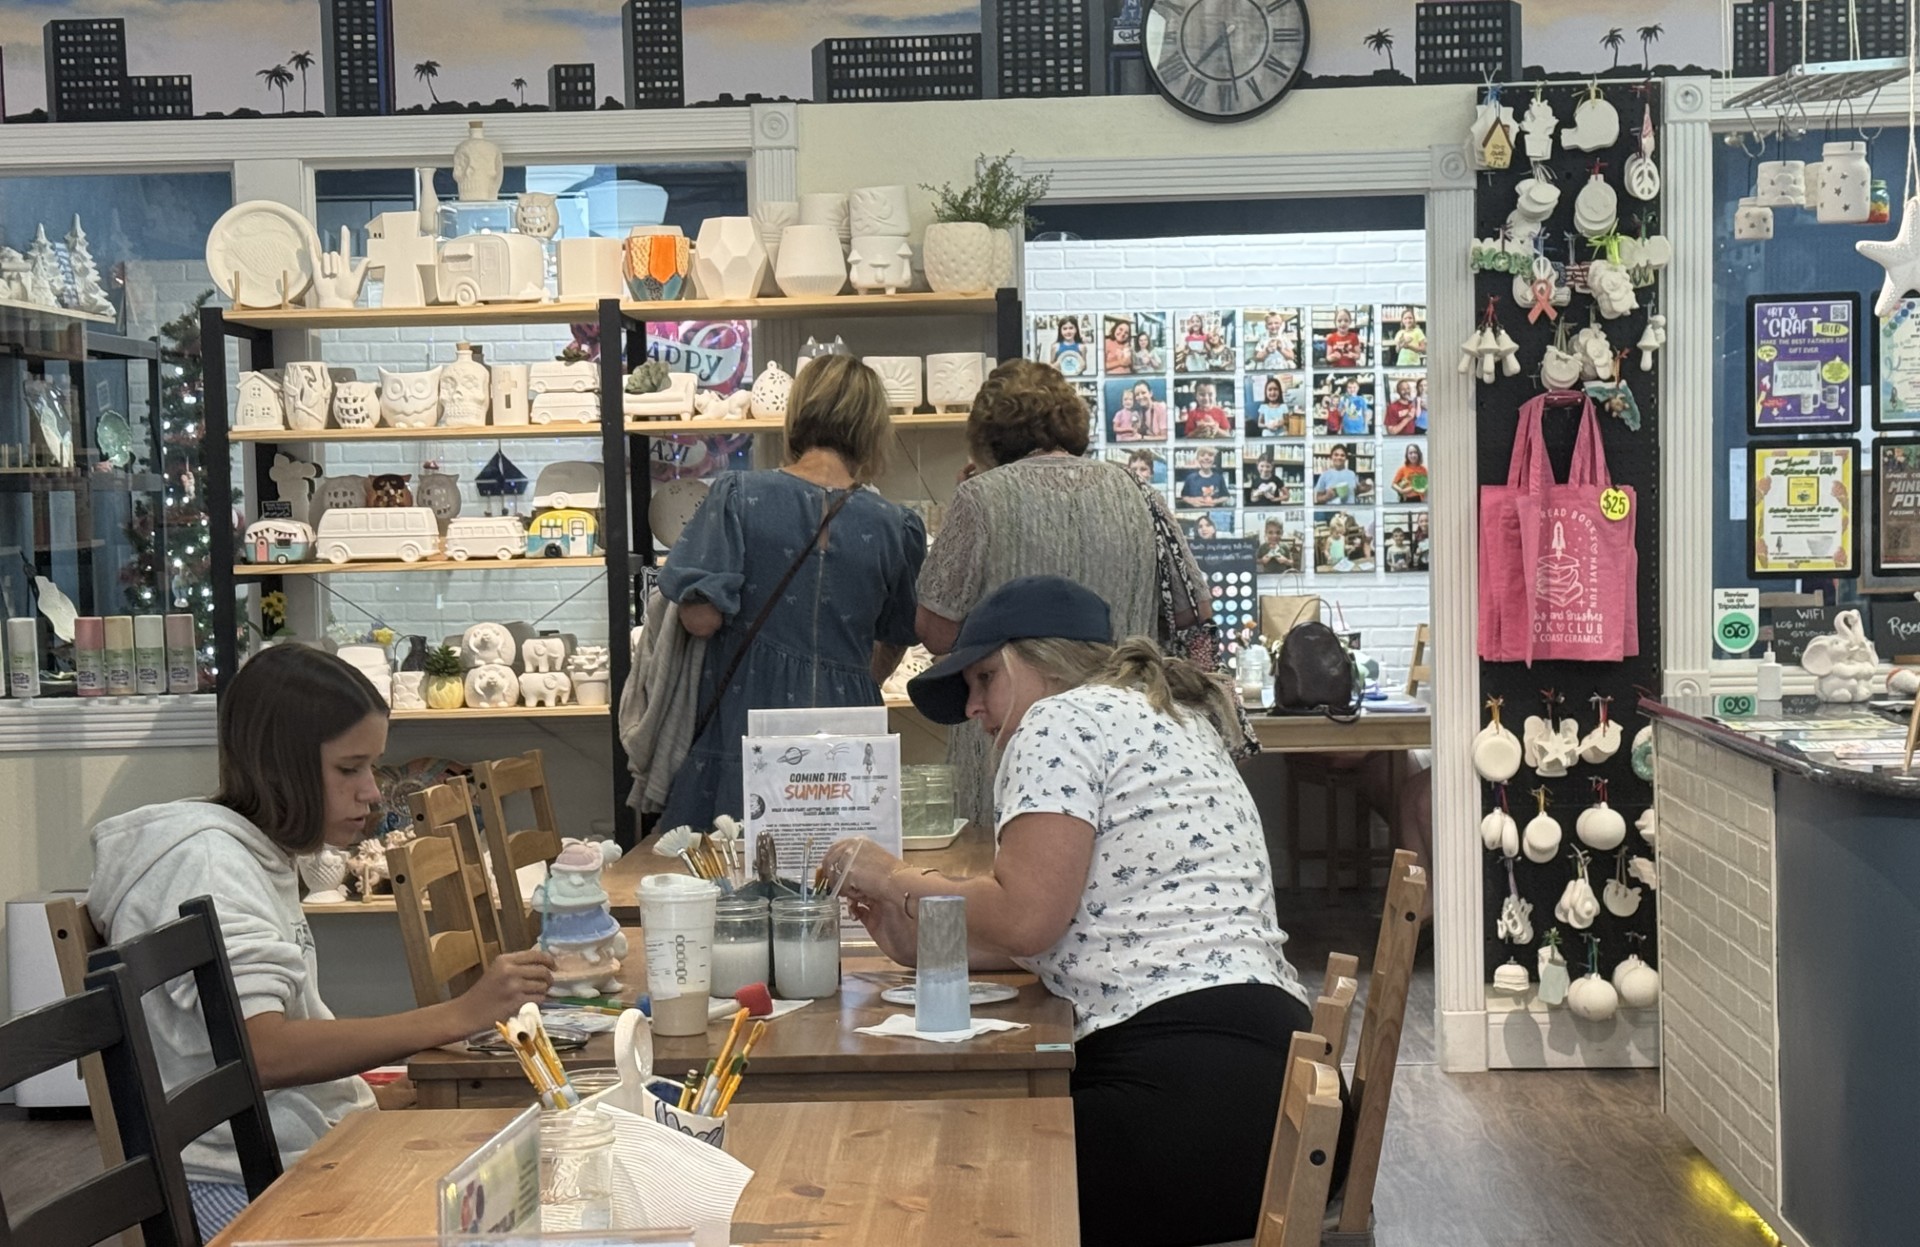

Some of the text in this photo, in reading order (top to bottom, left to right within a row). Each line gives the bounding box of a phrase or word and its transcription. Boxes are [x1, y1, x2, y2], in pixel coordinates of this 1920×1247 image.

[1272, 28, 1300, 42] III
[1244, 76, 1265, 102] V
[1788, 307, 1798, 320] &
[1768, 318, 1822, 338] CRAFT
[1804, 346, 1818, 354] EVER
[646, 341, 723, 381] APPY
[1602, 494, 1626, 516] $25
[1540, 508, 1598, 608] READ BOOKS HAVE FUN
[1718, 602, 1756, 610] Tripadvisor
[1550, 610, 1564, 620] and
[1566, 608, 1603, 622] Brushes
[1796, 608, 1824, 620] WIFI
[1568, 623, 1603, 634] CLUB
[1776, 620, 1792, 629] LOG
[1540, 634, 1564, 643] COAST
[1564, 634, 1603, 644] CERAMICS
[790, 773, 826, 782] COMING
[828, 772, 847, 781] THIS
[784, 784, 853, 801] SUMMER
